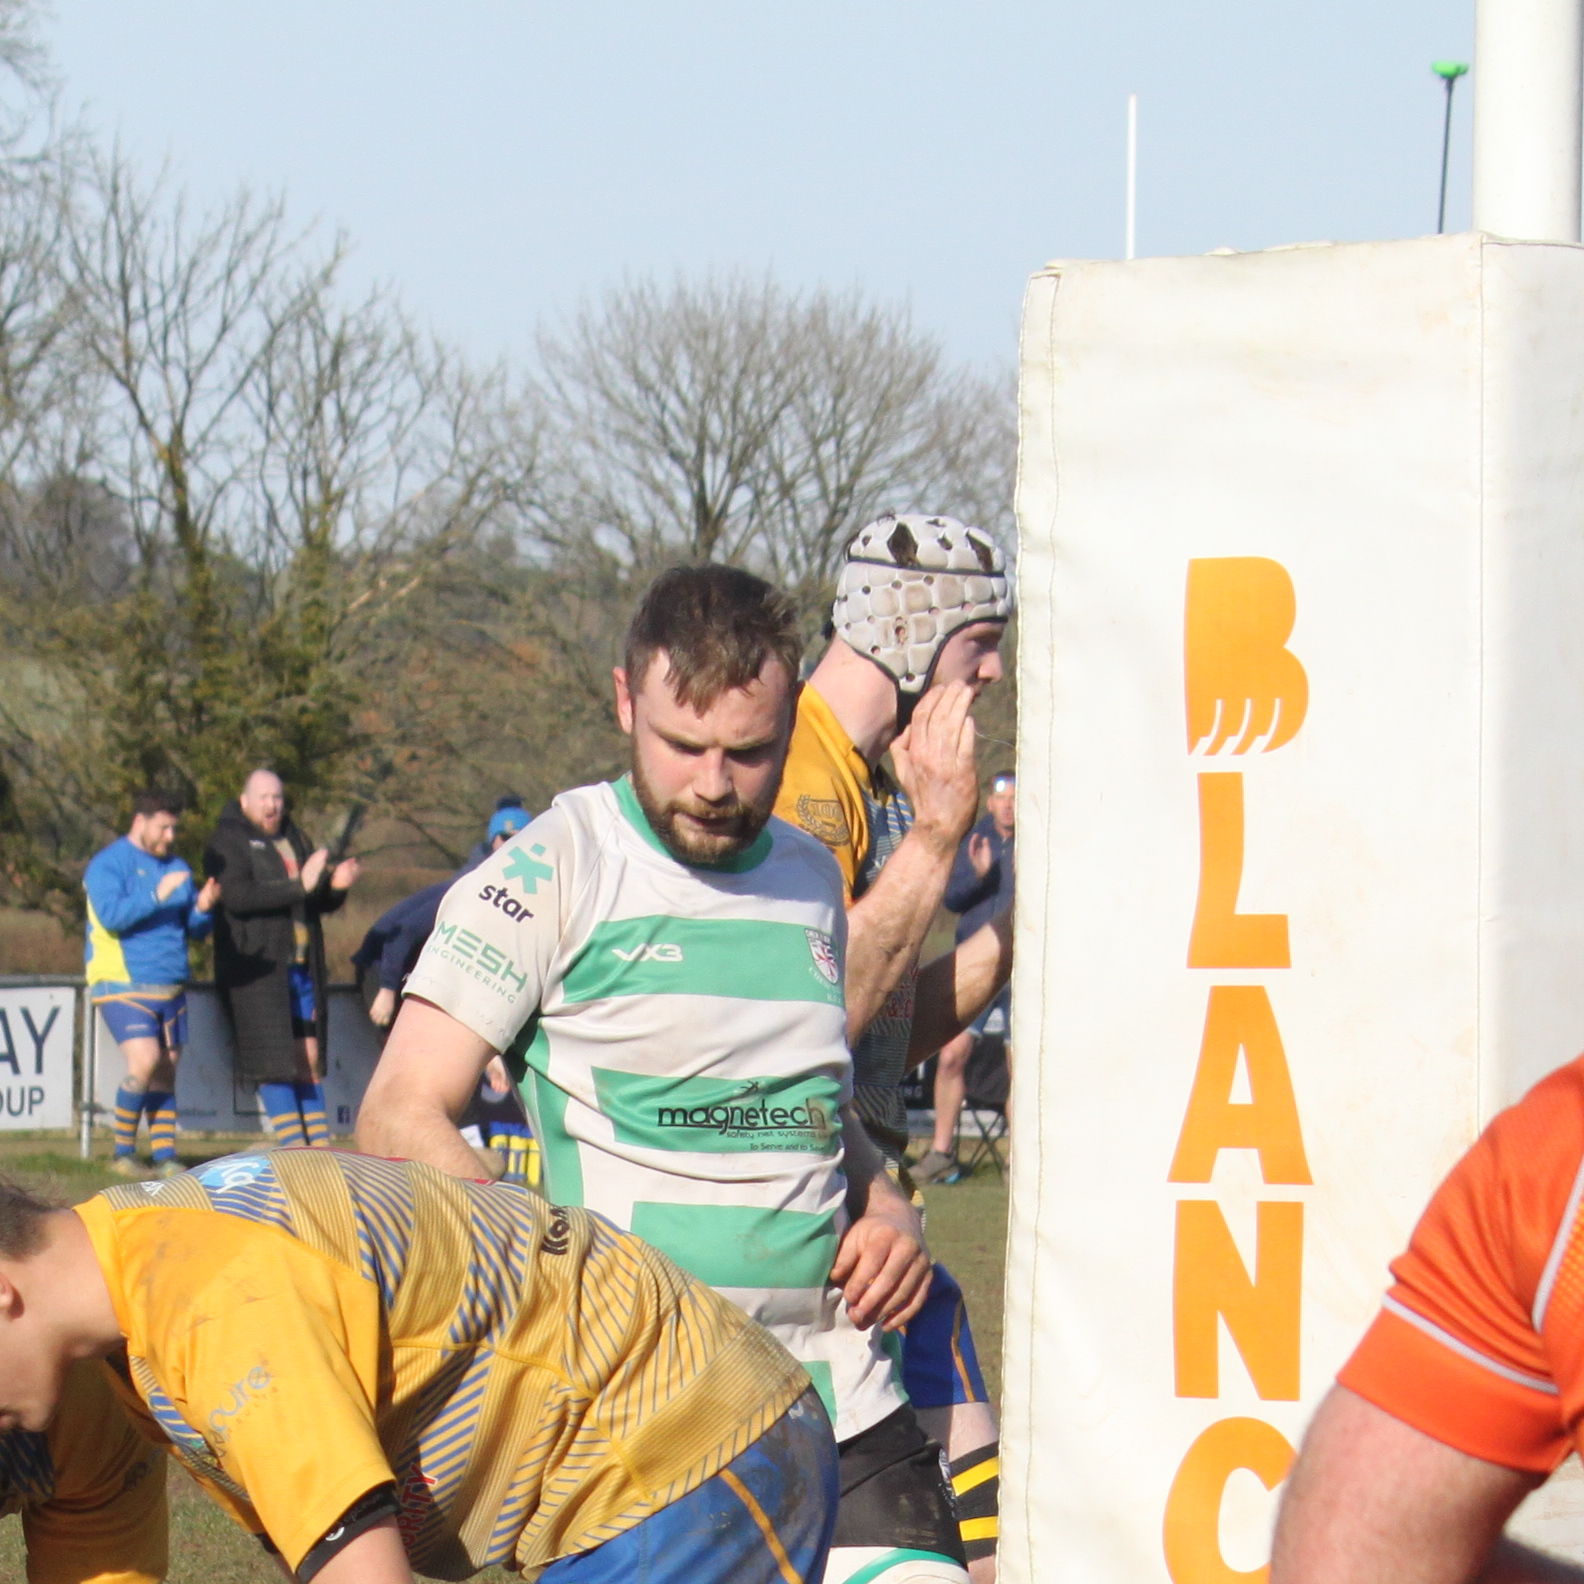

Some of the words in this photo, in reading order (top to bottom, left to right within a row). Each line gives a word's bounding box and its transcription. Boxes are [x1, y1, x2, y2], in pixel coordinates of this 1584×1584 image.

[478, 881, 535, 925] star
[426, 942, 516, 1005] ENGINEERING
[435, 919, 530, 994] MESH
[611, 942, 684, 962] VX3
[657, 1098, 827, 1136] magnetech
